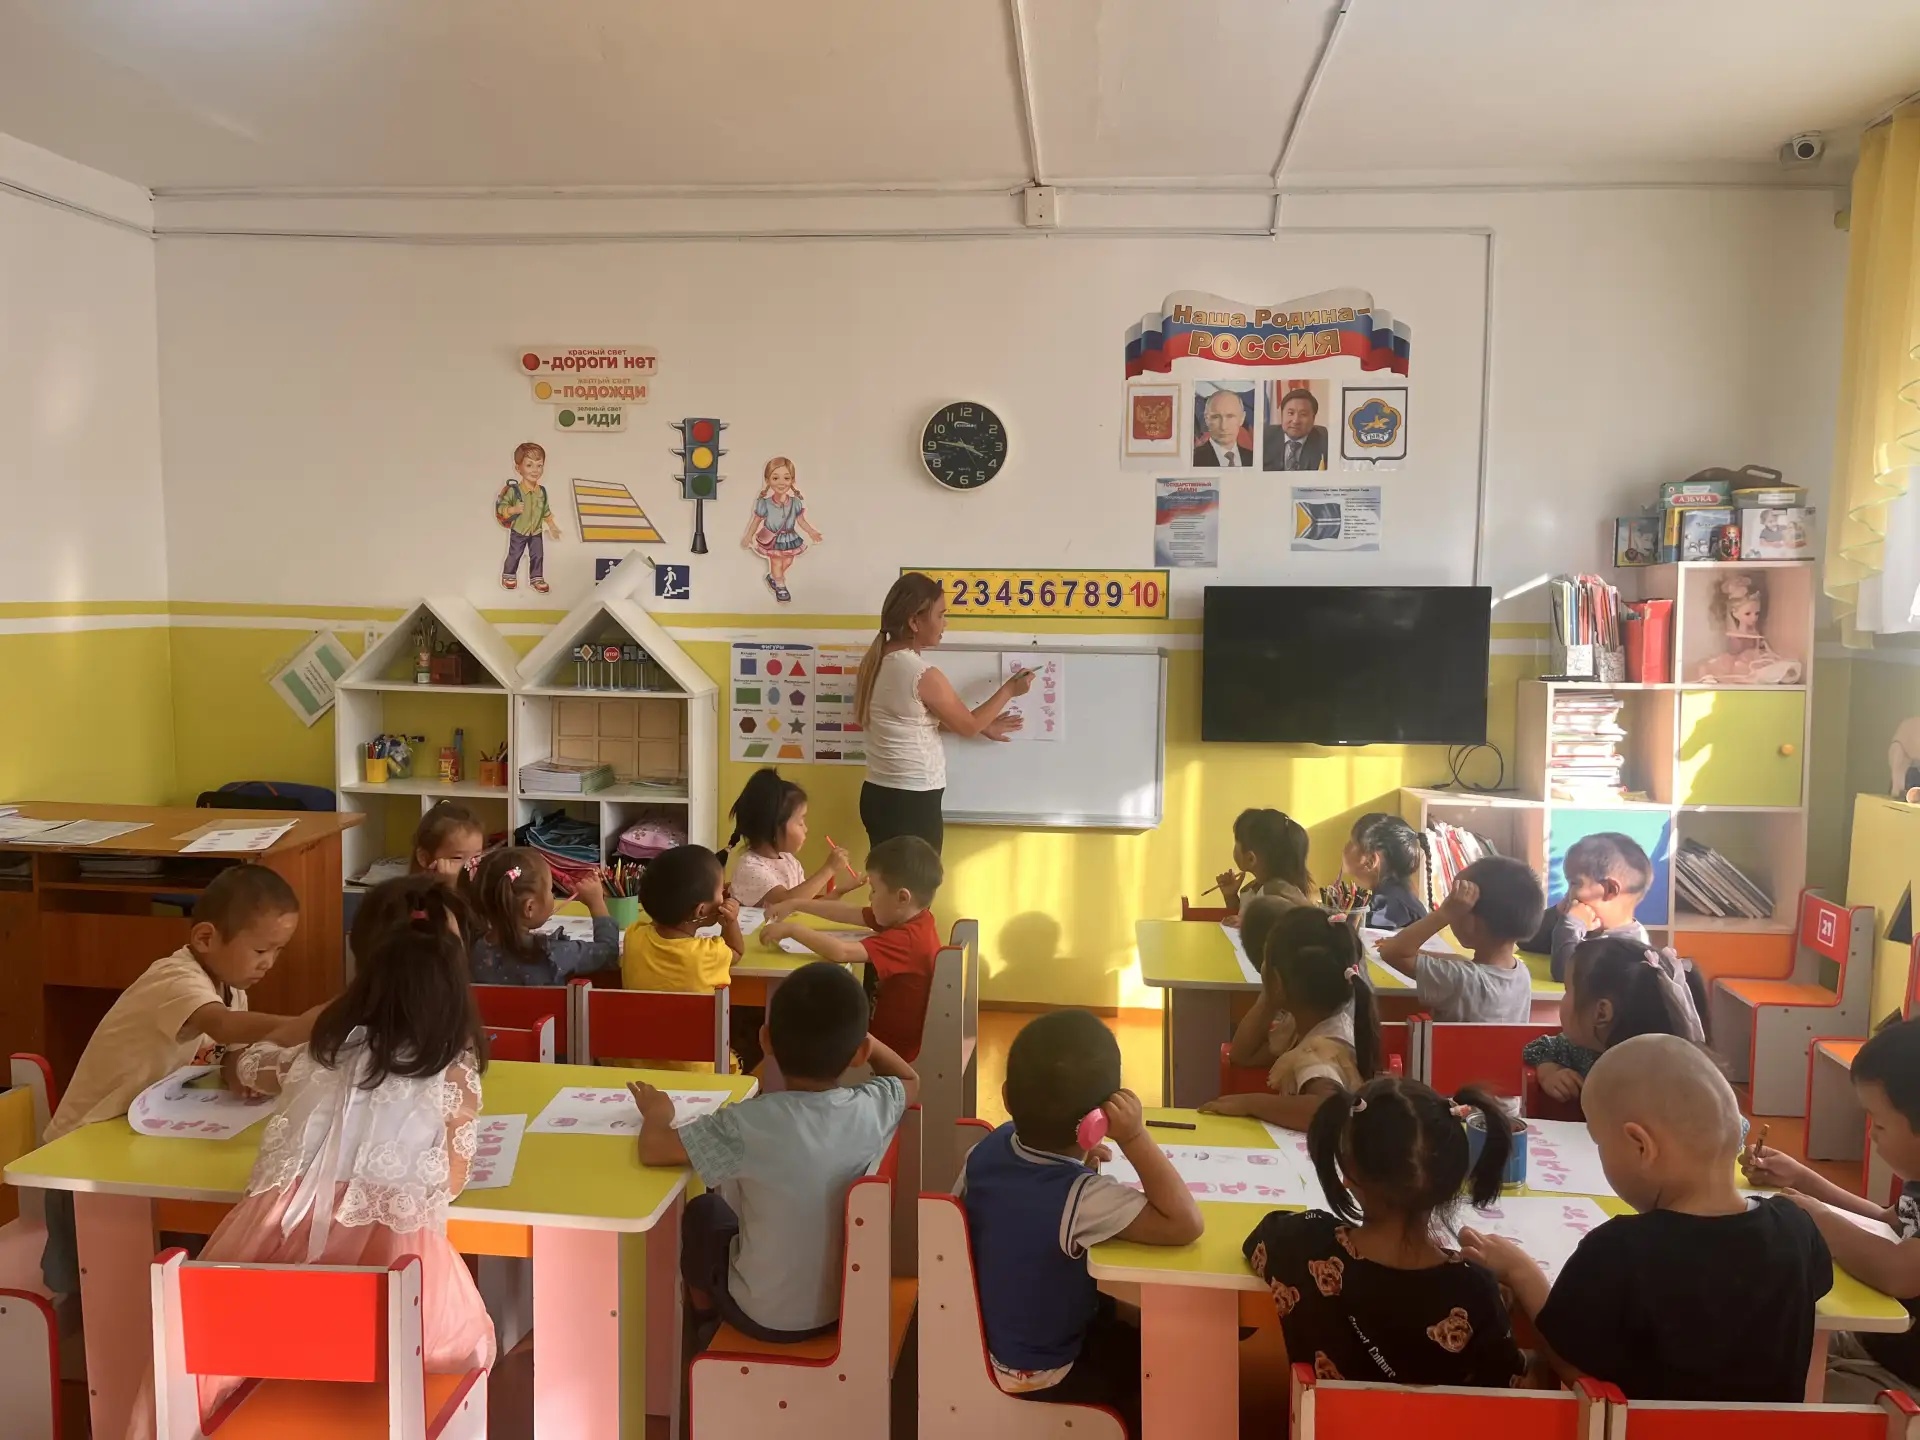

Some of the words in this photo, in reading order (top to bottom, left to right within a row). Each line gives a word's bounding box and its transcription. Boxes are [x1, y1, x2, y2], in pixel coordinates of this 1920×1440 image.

[1172, 304, 1247, 328] Наша
[1187, 328, 1342, 360] РОССИЯ
[568, 348, 604, 356] красный
[624, 357, 656, 369] нет
[946, 412, 954, 422] 11
[960, 407, 972, 417] 12
[980, 411, 984, 422] 1
[934, 424, 946, 434] 10
[989, 424, 998, 435] 2
[927, 441, 937, 451] 9
[995, 442, 1003, 452] 3
[932, 458, 942, 468] 8
[988, 459, 997, 468] 4
[946, 470, 954, 481] 7
[960, 475, 969, 485] 6
[976, 471, 985, 481] 5
[1679, 495, 1713, 503] АЗБУКА
[952, 580, 968, 605] 2
[973, 580, 990, 606] 3
[995, 580, 1012, 606] 4
[1018, 581, 1034, 606] 5
[1040, 581, 1056, 606] 6
[1062, 581, 1078, 606] 7
[1084, 581, 1100, 607] 8
[1106, 581, 1122, 607] 9
[1130, 582, 1159, 608] 10
[1821, 919, 1832, 936] 21
